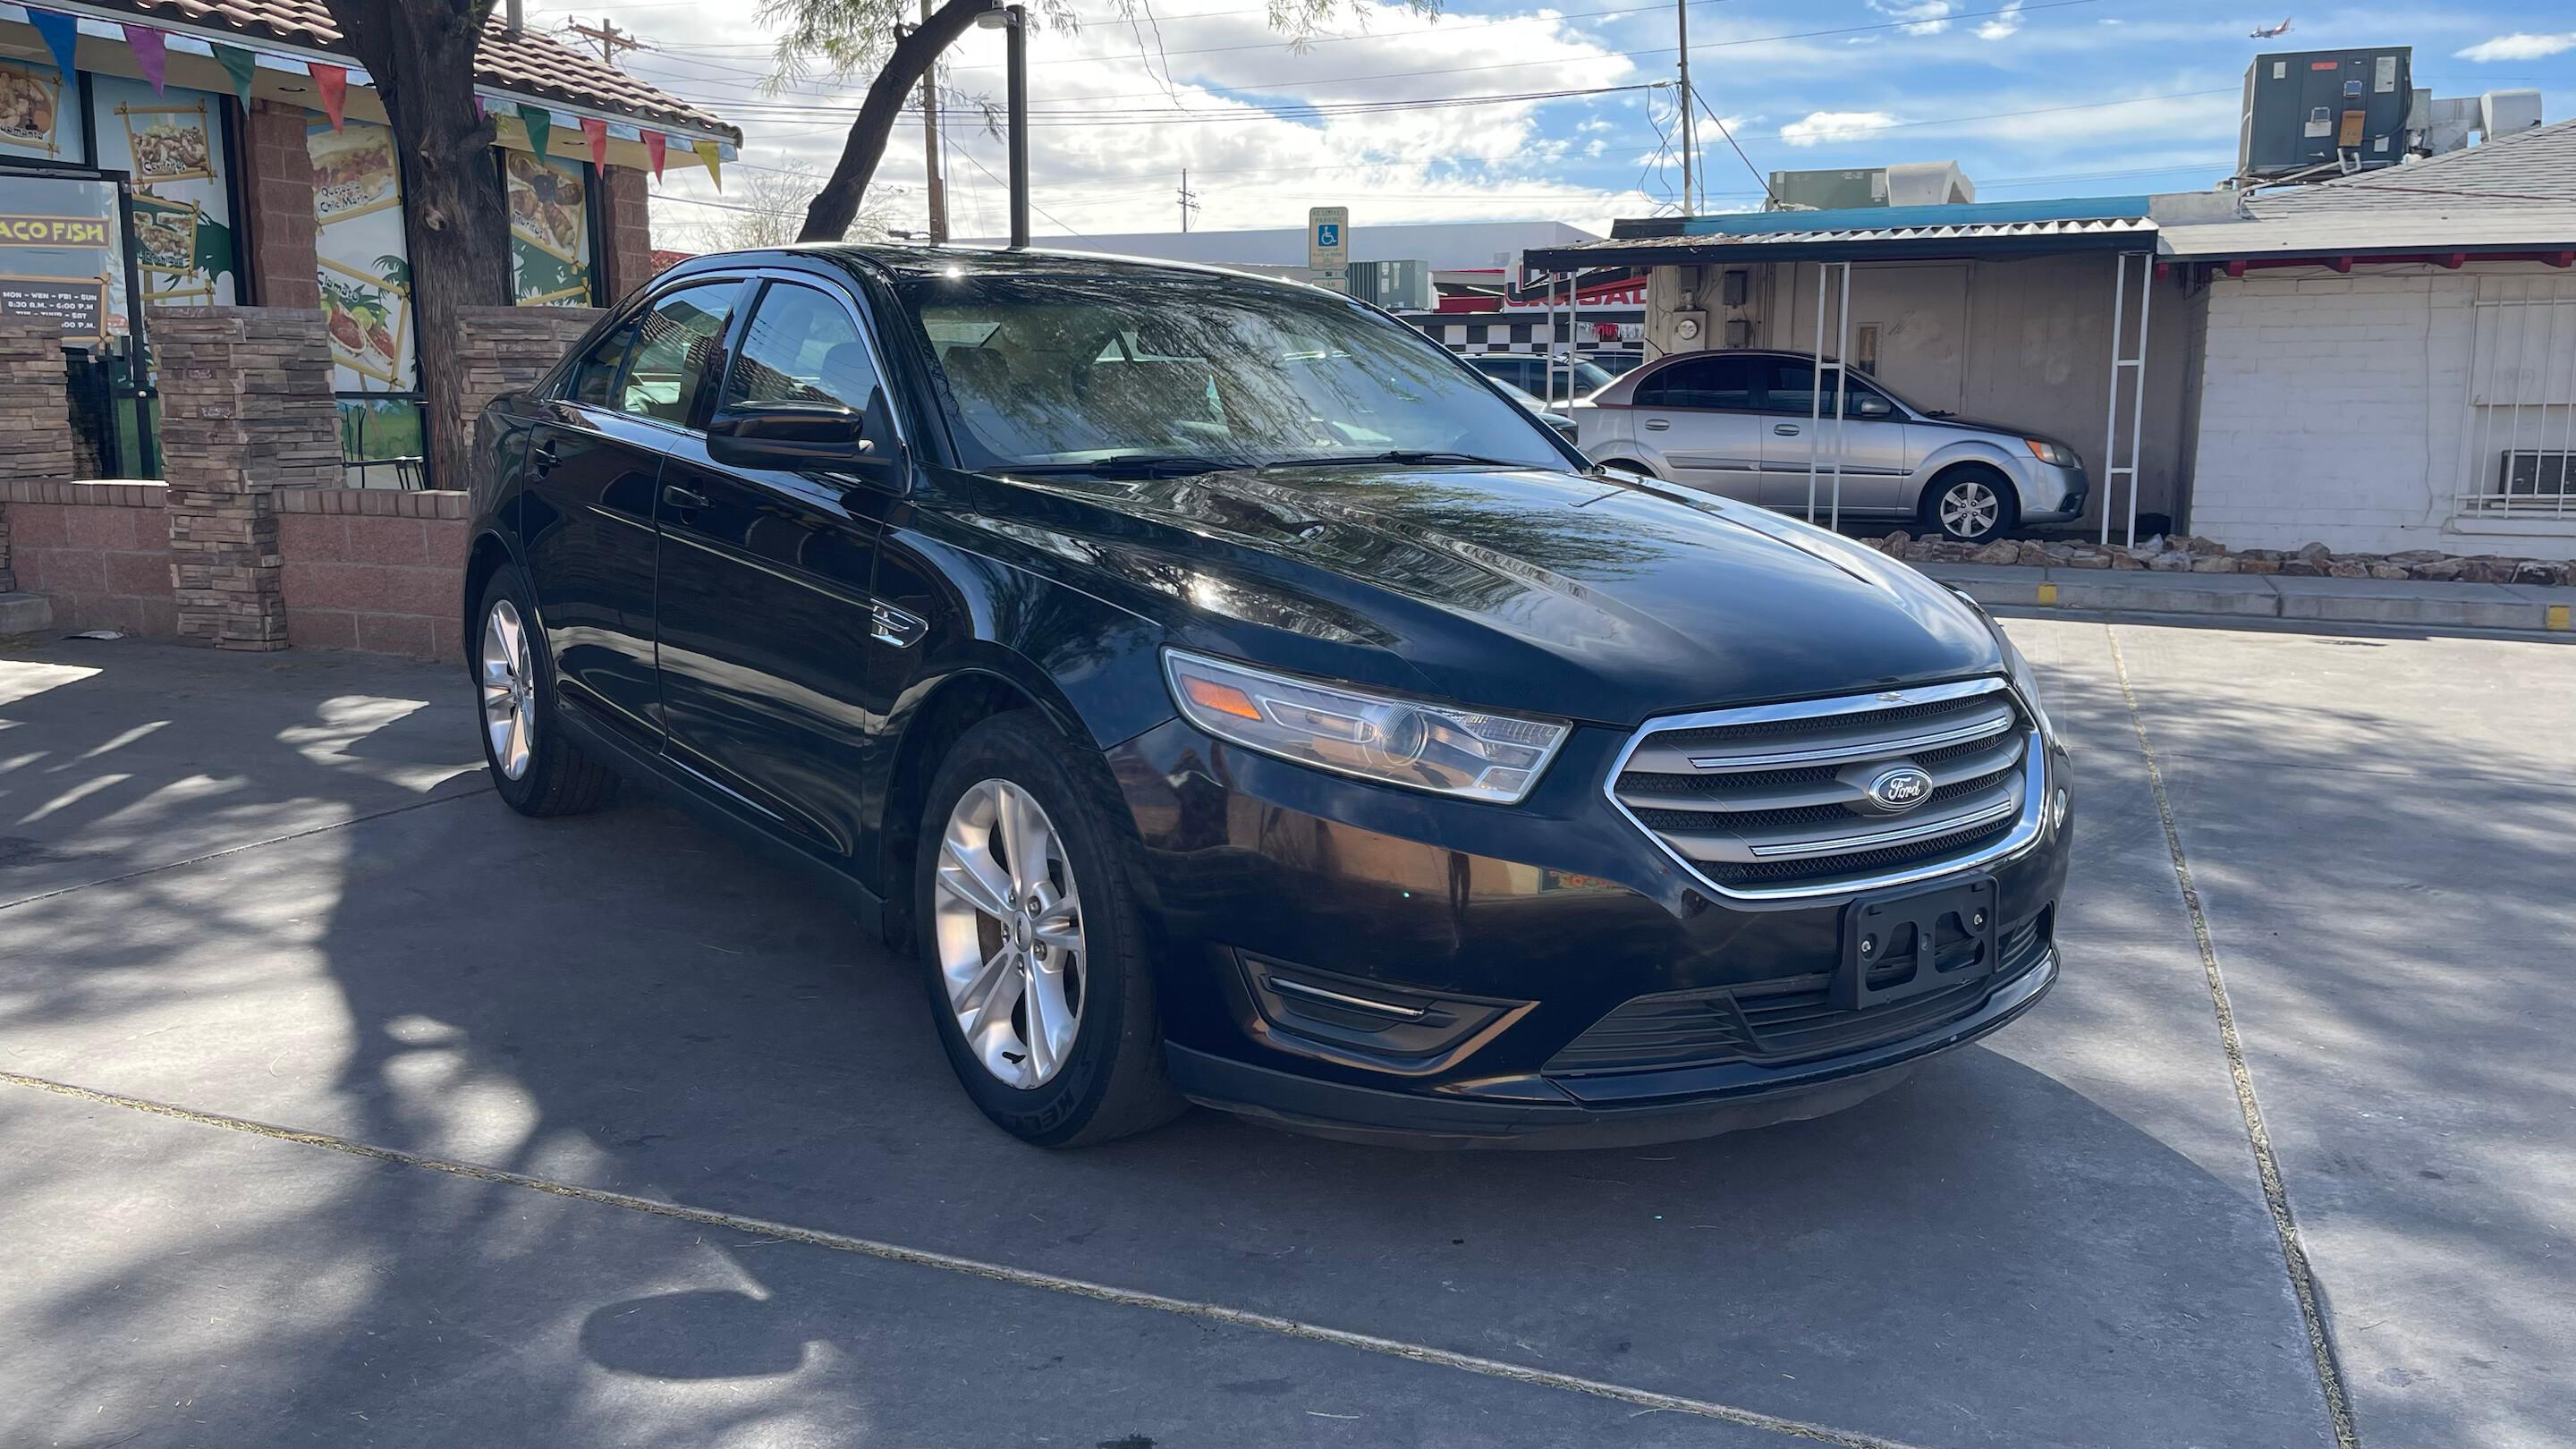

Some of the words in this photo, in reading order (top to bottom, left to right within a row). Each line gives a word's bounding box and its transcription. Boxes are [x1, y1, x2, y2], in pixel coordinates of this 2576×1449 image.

[53, 222, 104, 242] FISH
[316, 271, 360, 301] Clamato
[3, 291, 22, 299] MON
[31, 292, 49, 300] WEN
[57, 292, 72, 301] FRI
[30, 301, 47, 309] A.M.
[78, 321, 97, 329] P.M.
[1887, 776, 1921, 801] Ford
